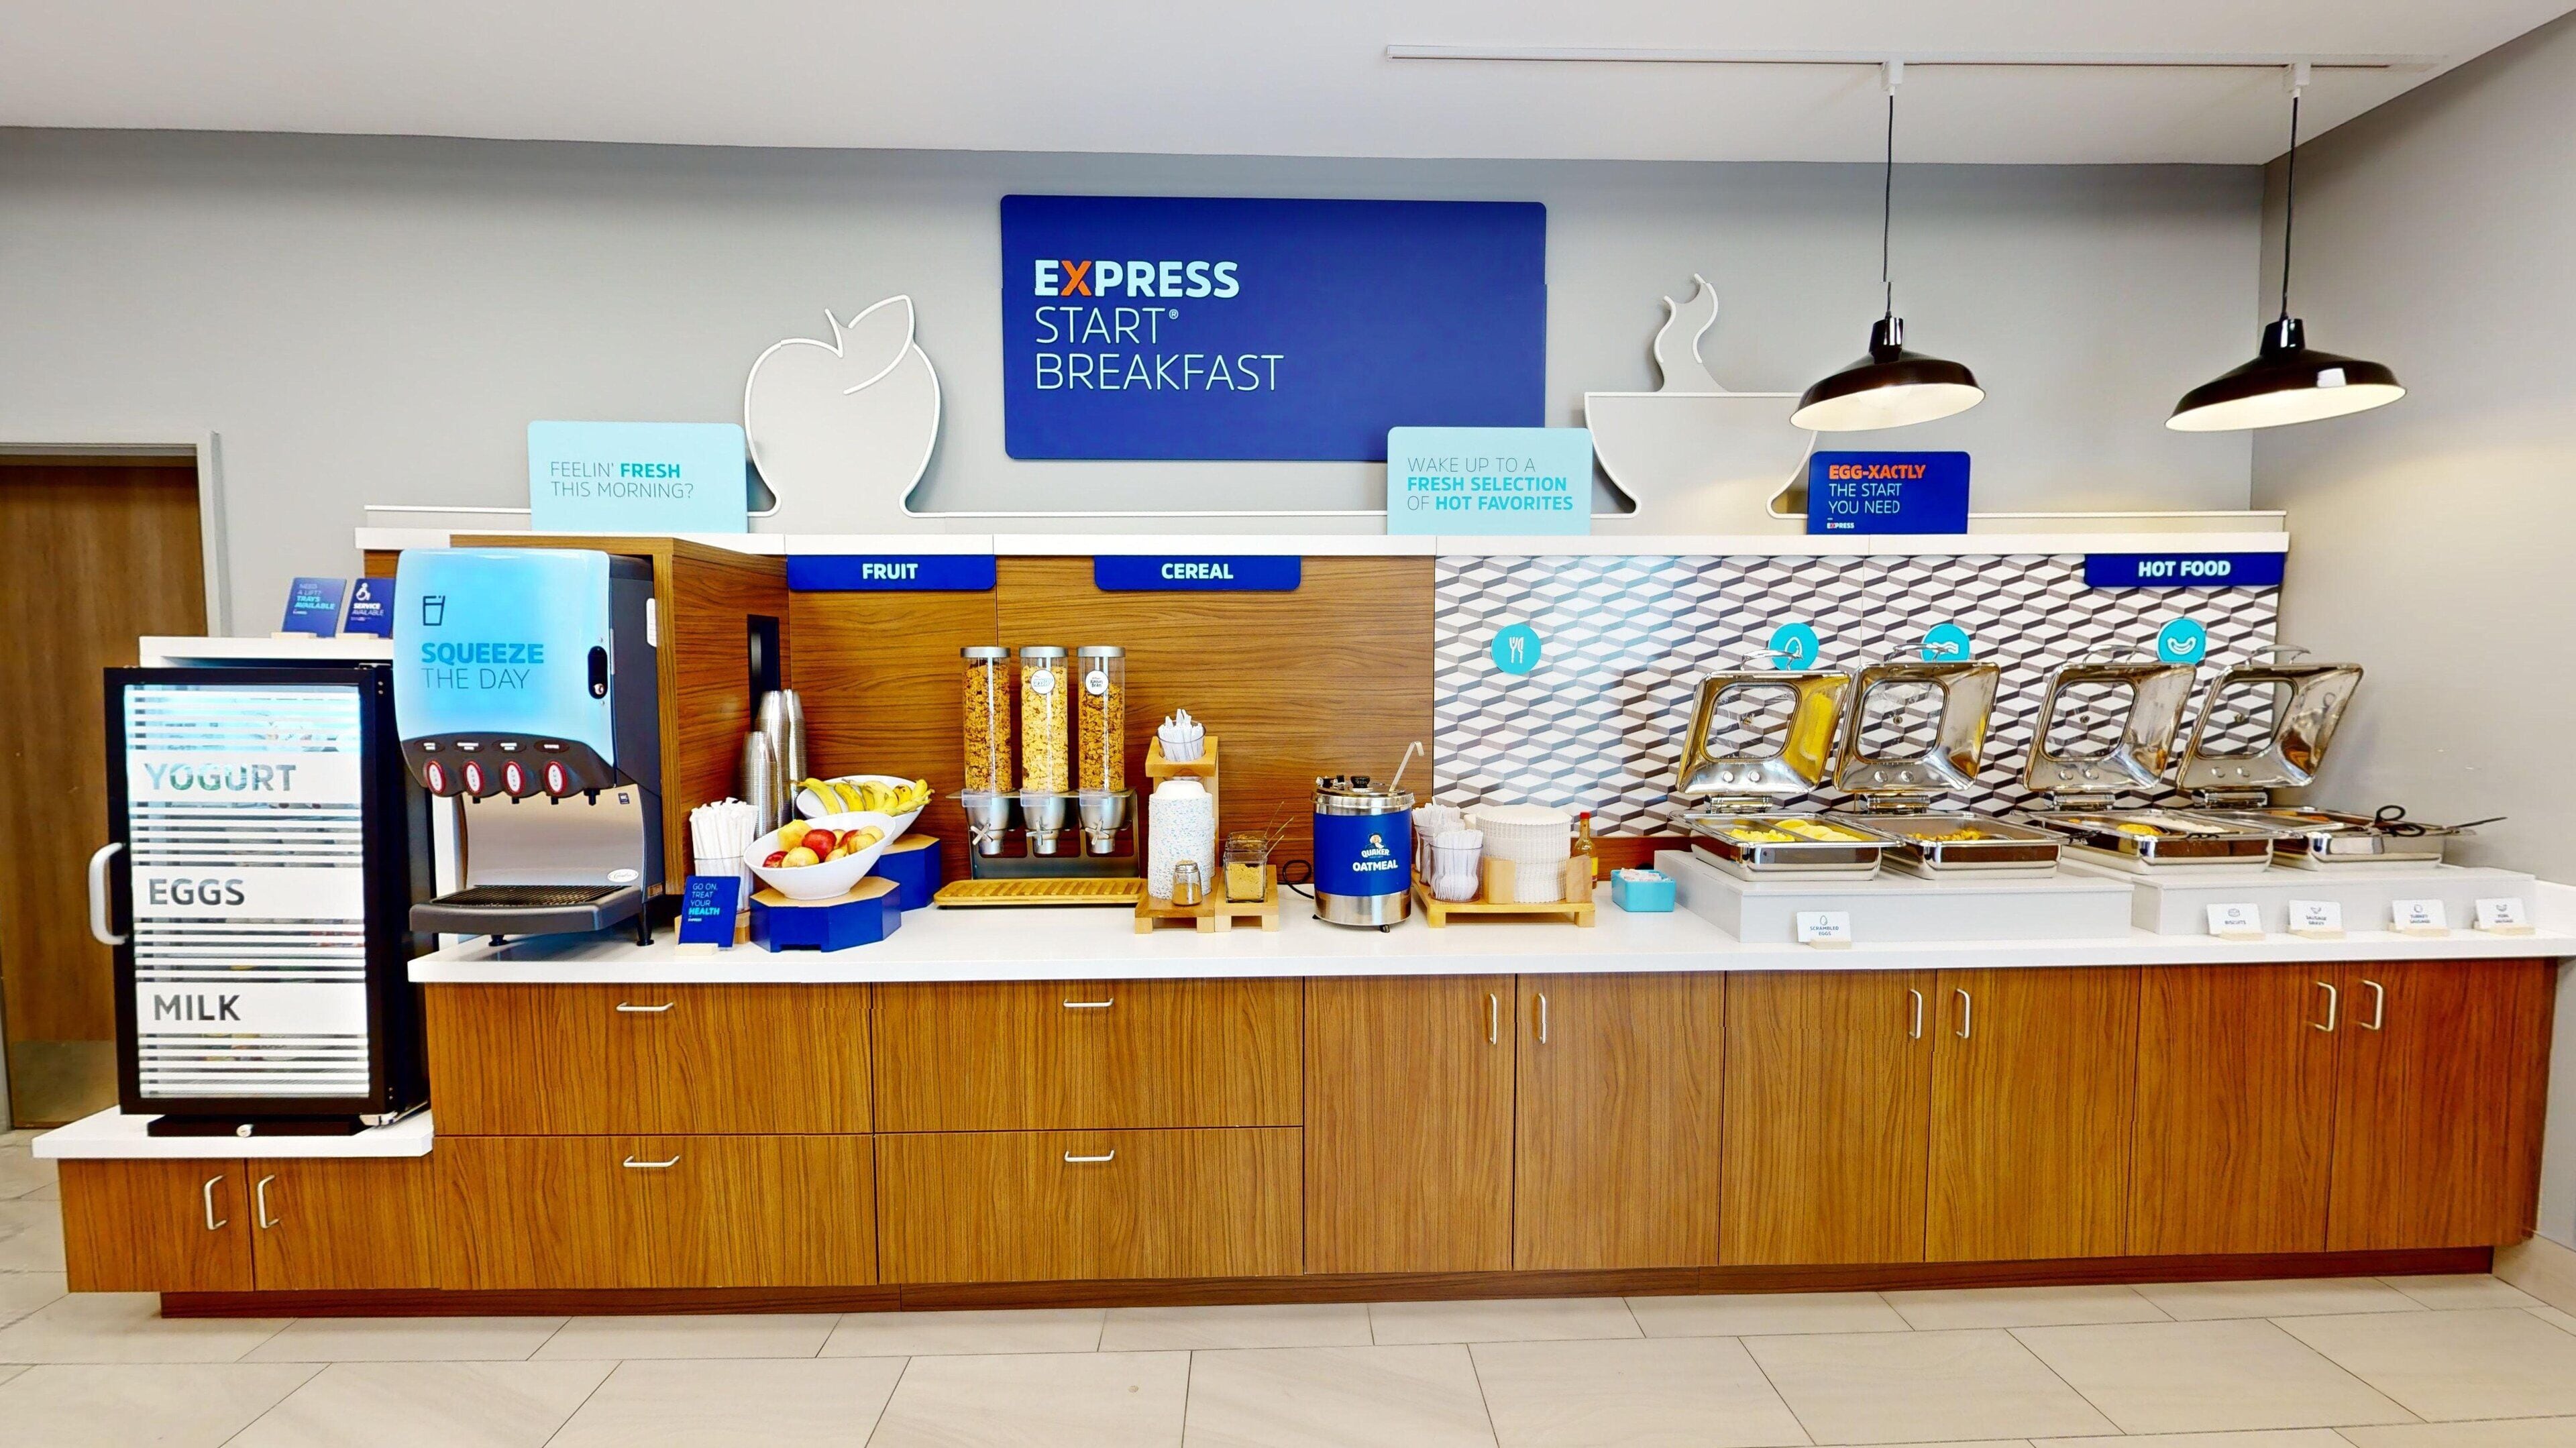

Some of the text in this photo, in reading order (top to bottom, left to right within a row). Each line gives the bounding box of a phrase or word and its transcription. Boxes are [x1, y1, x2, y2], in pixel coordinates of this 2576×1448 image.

[1034, 260, 1240, 298] EXPRESS
[1035, 352, 1285, 391] BREAKFAST
[550, 461, 680, 478] FEELIN' FRESH
[1407, 457, 1536, 472] WAKE UP TO A
[1829, 464, 1926, 480] EGG-XACTLY
[551, 481, 694, 498] THIS MORNING?
[1407, 477, 1566, 492] FRESH SELECTION
[1829, 483, 1902, 497] THE START
[1407, 496, 1573, 511] OF HOT FAVORITES
[1829, 500, 1900, 514] YOU NEED
[862, 563, 918, 579] FRUIT
[1161, 563, 1234, 579] CEREAL
[2138, 560, 2231, 577] HOT FOOD
[421, 643, 544, 666] SQUEEZE
[421, 668, 530, 689] THE DAY
[144, 763, 297, 791] YOGURT
[1361, 848, 1390, 858] QUAKER
[1352, 859, 1398, 872] OATMEAL
[149, 877, 246, 906] EGGS
[688, 907, 720, 915] HEALTH
[154, 994, 241, 1021] MILK
